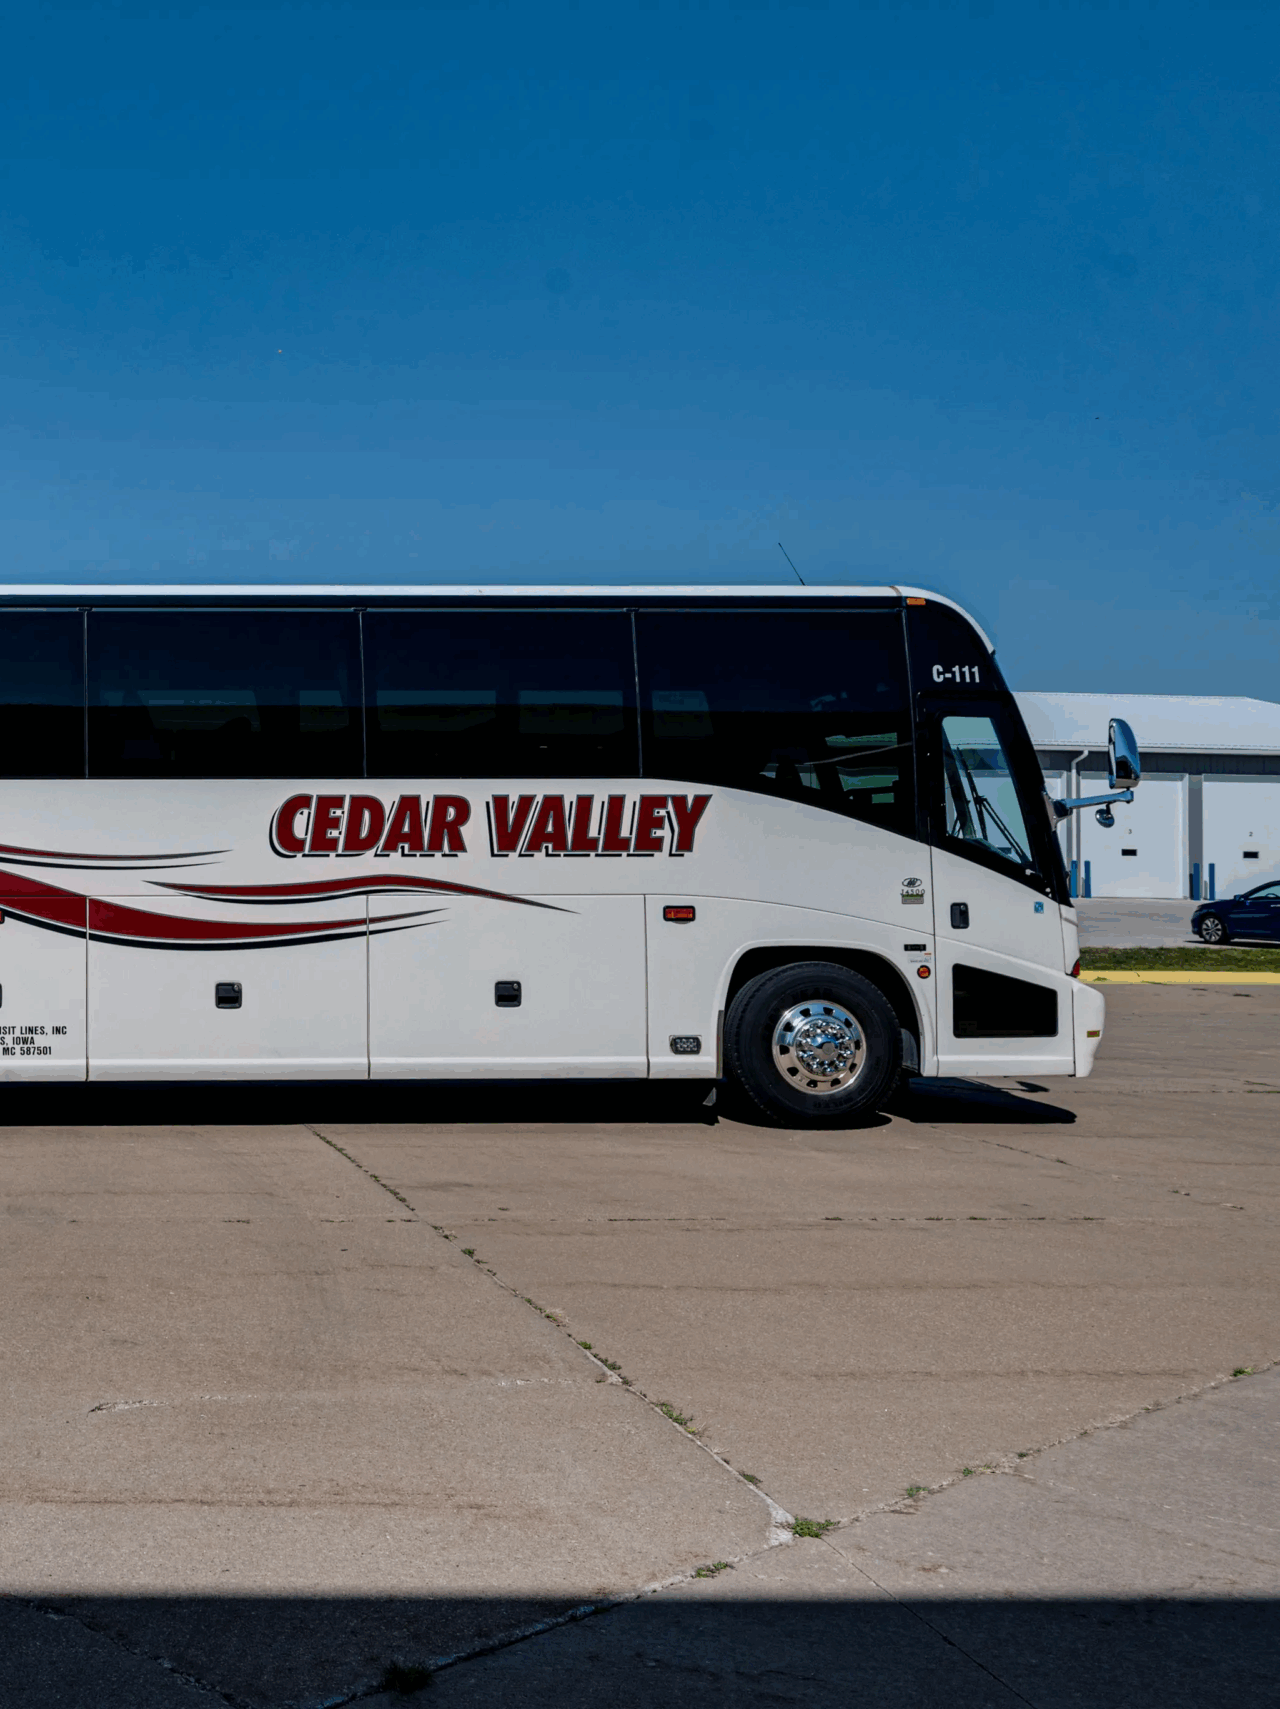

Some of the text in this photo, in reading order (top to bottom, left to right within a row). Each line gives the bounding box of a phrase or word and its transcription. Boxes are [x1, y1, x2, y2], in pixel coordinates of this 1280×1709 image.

[932, 664, 980, 683] C-111
[269, 793, 713, 858] CEDAR VALLEY
[20, 1025, 48, 1036] LINES,
[52, 1025, 67, 1035] INC
[12, 1036, 36, 1046] IOWA
[2, 1046, 16, 1056] MC
[20, 1046, 52, 1056] 587501
